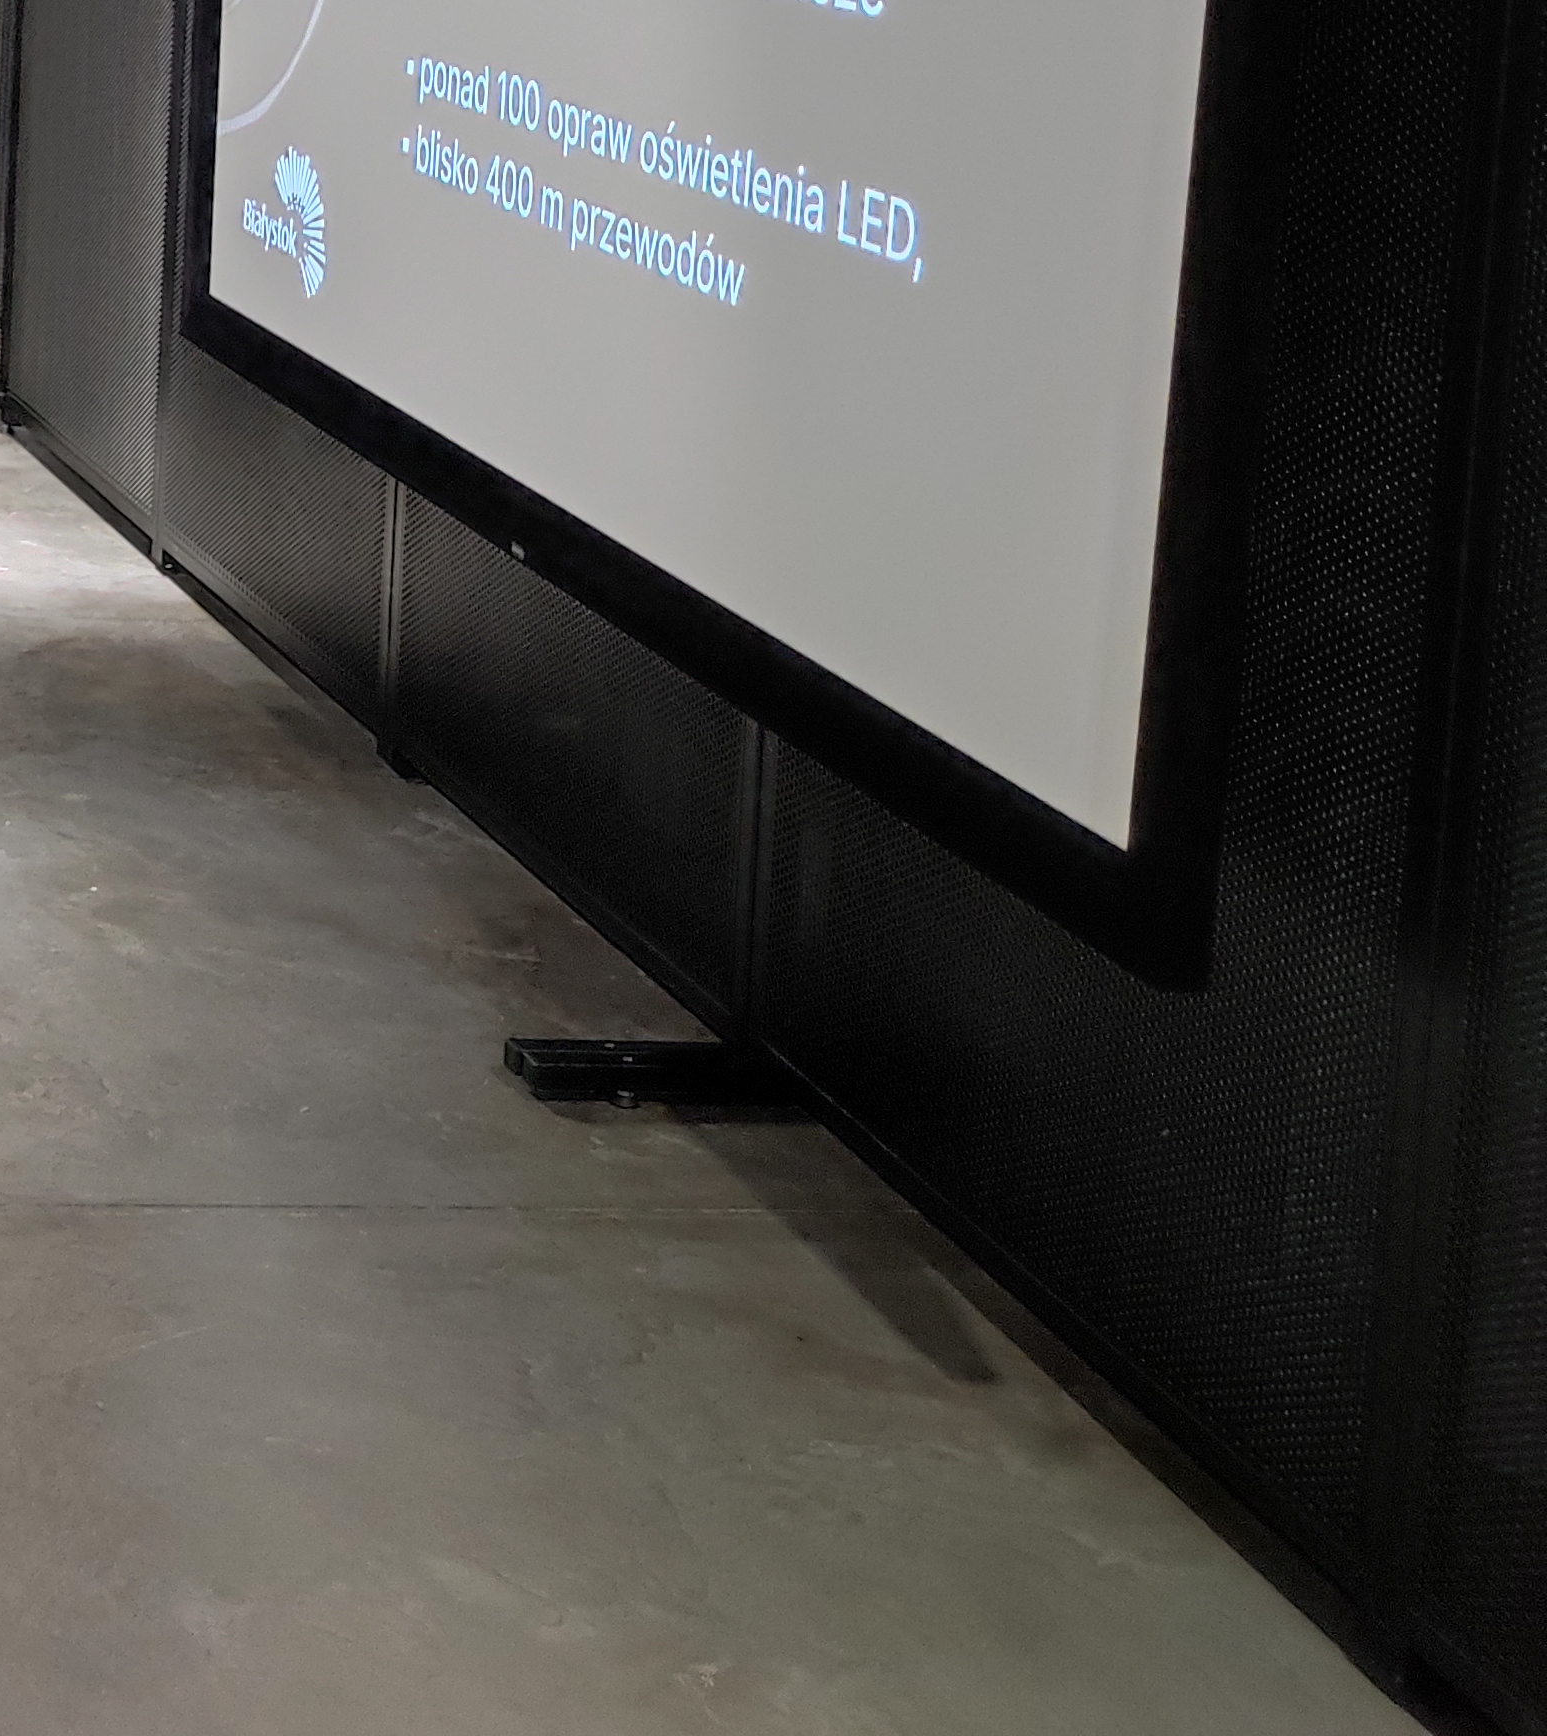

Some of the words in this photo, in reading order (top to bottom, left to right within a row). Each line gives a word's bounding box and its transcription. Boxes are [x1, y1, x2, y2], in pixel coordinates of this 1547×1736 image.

[242, 198, 298, 259] Białystok
[415, 124, 479, 195] blisko
[485, 154, 534, 218] 400
[540, 185, 564, 233] m
[570, 199, 747, 307] przewodów
[419, 57, 490, 116] ponad
[497, 70, 541, 131] 100
[547, 99, 633, 164] opraw
[639, 120, 824, 234] oświetlenia
[836, 179, 923, 283] LED,
